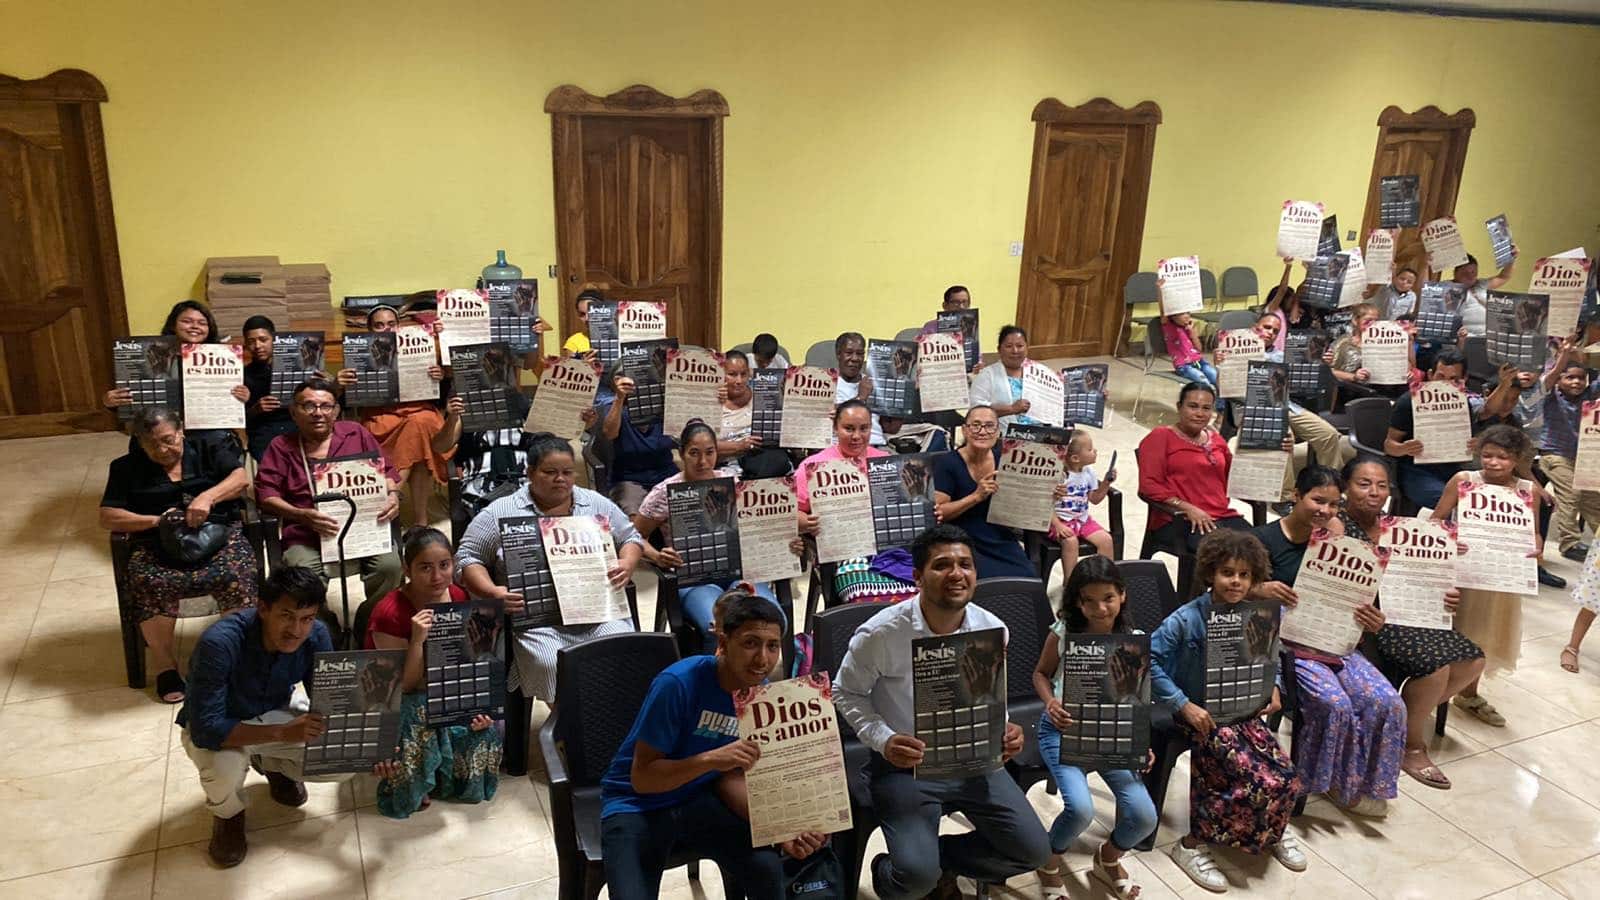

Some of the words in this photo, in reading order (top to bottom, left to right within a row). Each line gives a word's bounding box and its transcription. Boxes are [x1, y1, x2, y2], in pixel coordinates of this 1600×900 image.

[1288, 206, 1318, 218] Dios
[1295, 216, 1320, 225] amor
[1425, 224, 1453, 236] Dios
[1435, 228, 1457, 239] amor
[1371, 233, 1391, 244] Dios
[1165, 261, 1193, 273] Dios
[1172, 270, 1195, 278] amor
[1541, 265, 1581, 279] Dios
[1549, 279, 1585, 288] amor
[445, 296, 482, 310] Dios
[455, 310, 487, 318] amor
[626, 309, 660, 322] Dios
[635, 322, 664, 330] amor
[1368, 326, 1402, 338] Dios
[113, 340, 142, 350] Jesús
[273, 335, 298, 345] Jesús
[343, 335, 368, 345] Jesús
[1226, 335, 1259, 349] Dios
[1377, 337, 1407, 345] amor
[402, 345, 433, 356] amor
[450, 348, 478, 360] Jesús
[622, 346, 648, 356] Jesús
[923, 341, 958, 355] Dios
[1234, 346, 1263, 355] amor
[192, 352, 236, 367] Dios
[934, 353, 961, 362] amor
[204, 367, 240, 375] amor
[675, 357, 717, 374] Dios
[551, 364, 593, 384] Dios
[669, 373, 684, 381] es
[686, 374, 722, 384] amor
[793, 373, 831, 389] Dios
[1030, 366, 1059, 385] Dios
[543, 379, 558, 387] es
[560, 383, 595, 393] amor
[802, 389, 834, 398] amor
[1419, 388, 1459, 404] Dios
[1415, 405, 1430, 413] es
[1432, 401, 1465, 412] amor
[1007, 427, 1037, 441] Jesús
[1010, 449, 1057, 468] Dios
[869, 461, 897, 473] Jesús
[1002, 463, 1017, 472] es
[1020, 467, 1060, 477] amor
[327, 470, 377, 489] Dios
[817, 469, 860, 488] Dios
[341, 485, 384, 497] amor
[669, 486, 699, 500] Jesús
[743, 488, 789, 508] Dios
[812, 490, 827, 499] es
[831, 484, 866, 497] amor
[1470, 492, 1524, 515] Dios
[737, 510, 752, 519] es
[756, 504, 795, 517] amor
[1463, 511, 1481, 520] es
[1485, 512, 1531, 528] amor
[501, 522, 535, 536] Jesús
[552, 528, 600, 545] Dio
[1391, 527, 1447, 548] Dios
[550, 545, 566, 556] es
[1392, 547, 1401, 556] s
[1405, 547, 1453, 560] amor
[1317, 542, 1375, 575] Dios
[1306, 559, 1324, 573] es
[1328, 565, 1377, 588] amor
[1207, 609, 1242, 624] Jesús
[914, 642, 956, 662] Jesús
[1065, 640, 1106, 656] Jesús
[314, 657, 356, 673] Jesús
[751, 696, 822, 730] Dios
[747, 730, 770, 746] es
[775, 716, 832, 742] amor
